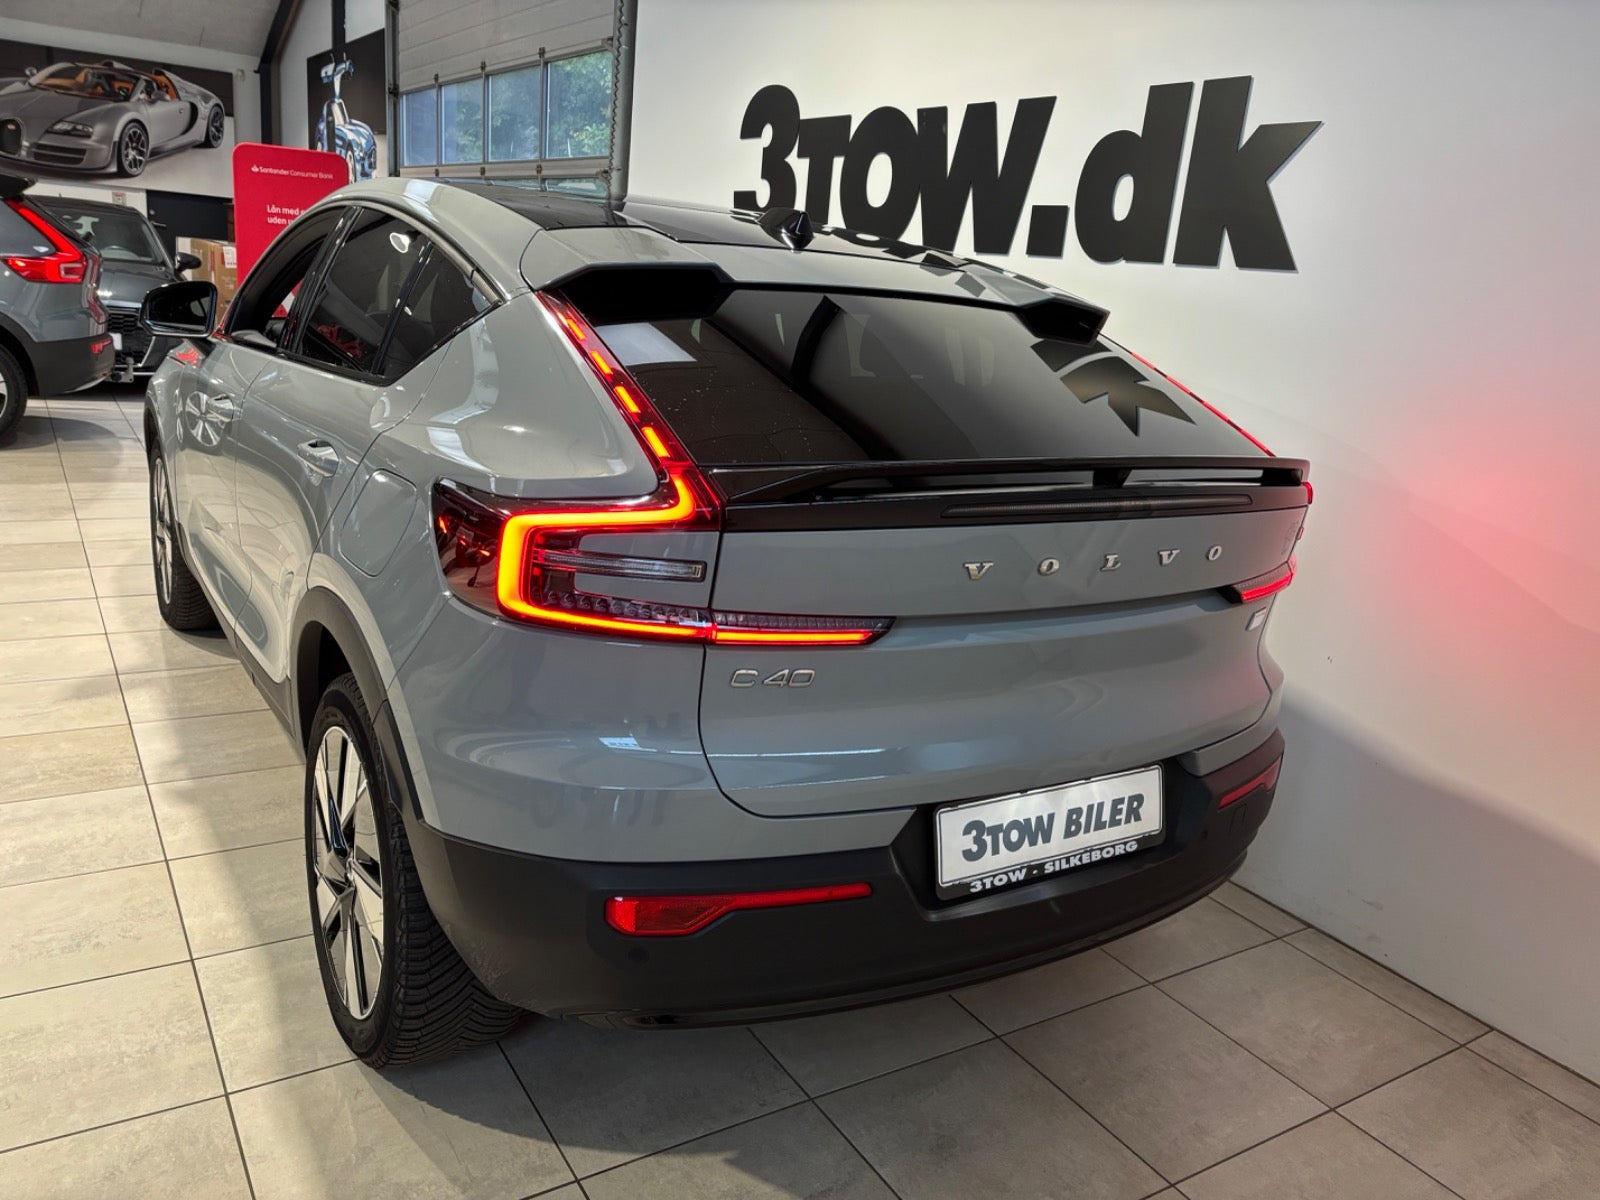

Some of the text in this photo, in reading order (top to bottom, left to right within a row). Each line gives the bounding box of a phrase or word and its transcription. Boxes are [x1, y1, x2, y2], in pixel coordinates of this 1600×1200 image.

[259, 167, 289, 175] Santander
[290, 169, 318, 178] Consumer
[733, 75, 1322, 272] 3TOW.dk
[267, 204, 280, 213] Lån
[267, 216, 286, 224] uden
[964, 545, 1223, 581] VOLVO
[961, 793, 1145, 862] 3TOW BILER
[969, 868, 1028, 893] 3TOW
[1044, 840, 1139, 874] SILKEBORG
